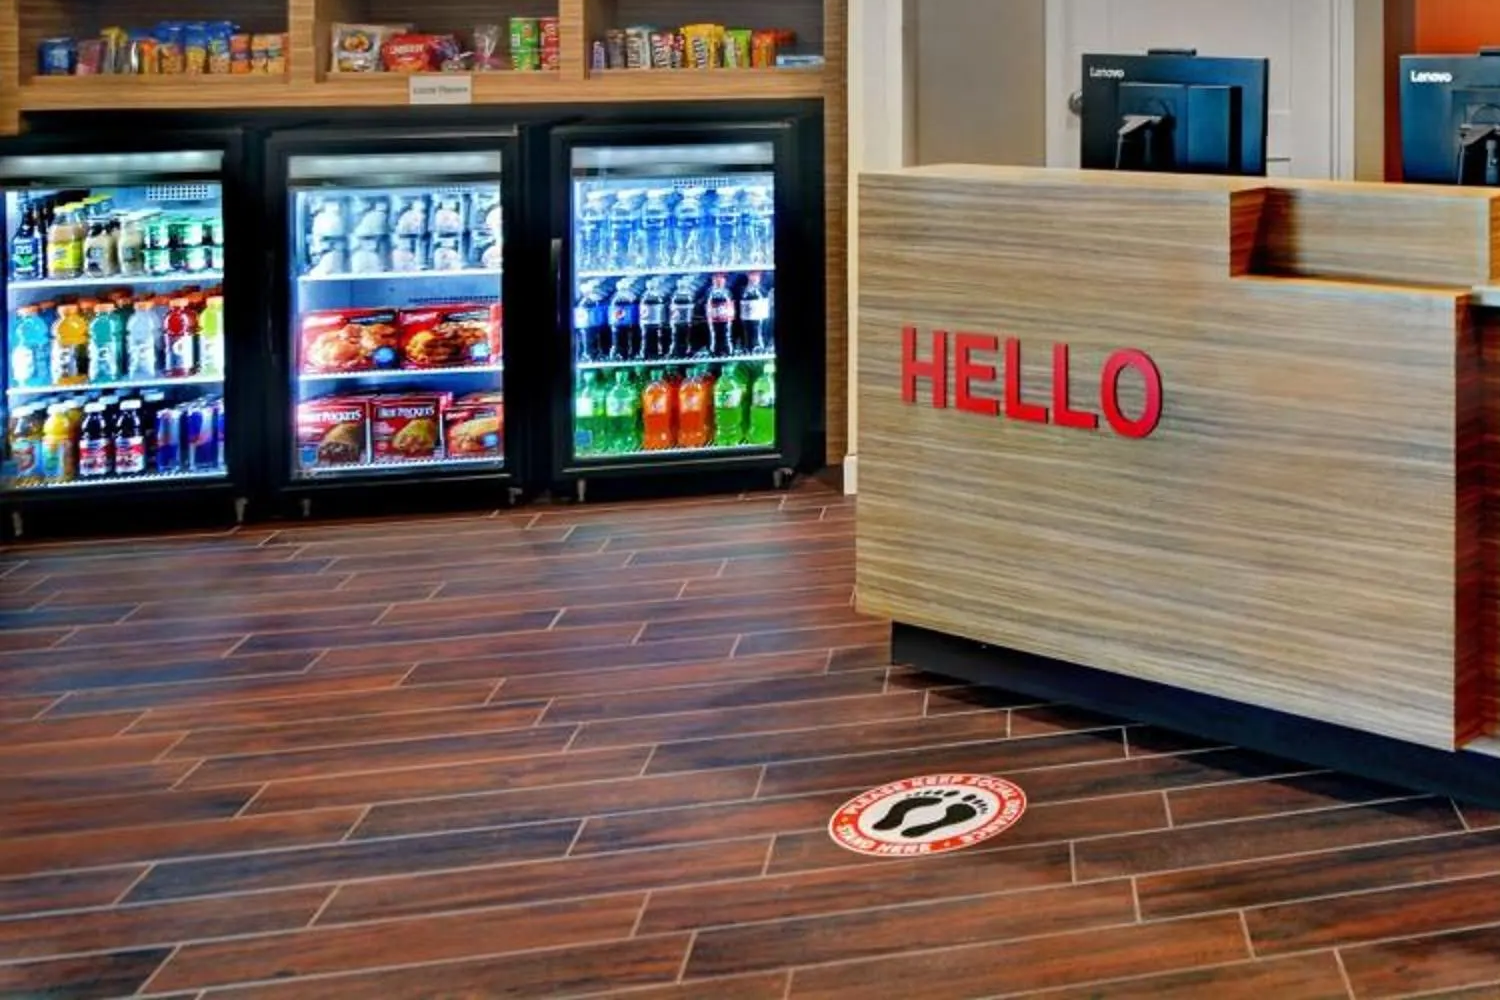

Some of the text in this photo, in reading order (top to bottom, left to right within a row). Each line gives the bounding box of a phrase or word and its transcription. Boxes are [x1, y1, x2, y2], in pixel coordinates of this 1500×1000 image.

[1090, 66, 1125, 79] Lenovo
[1410, 69, 1453, 83] Lenovo
[901, 325, 1163, 440] HELLO
